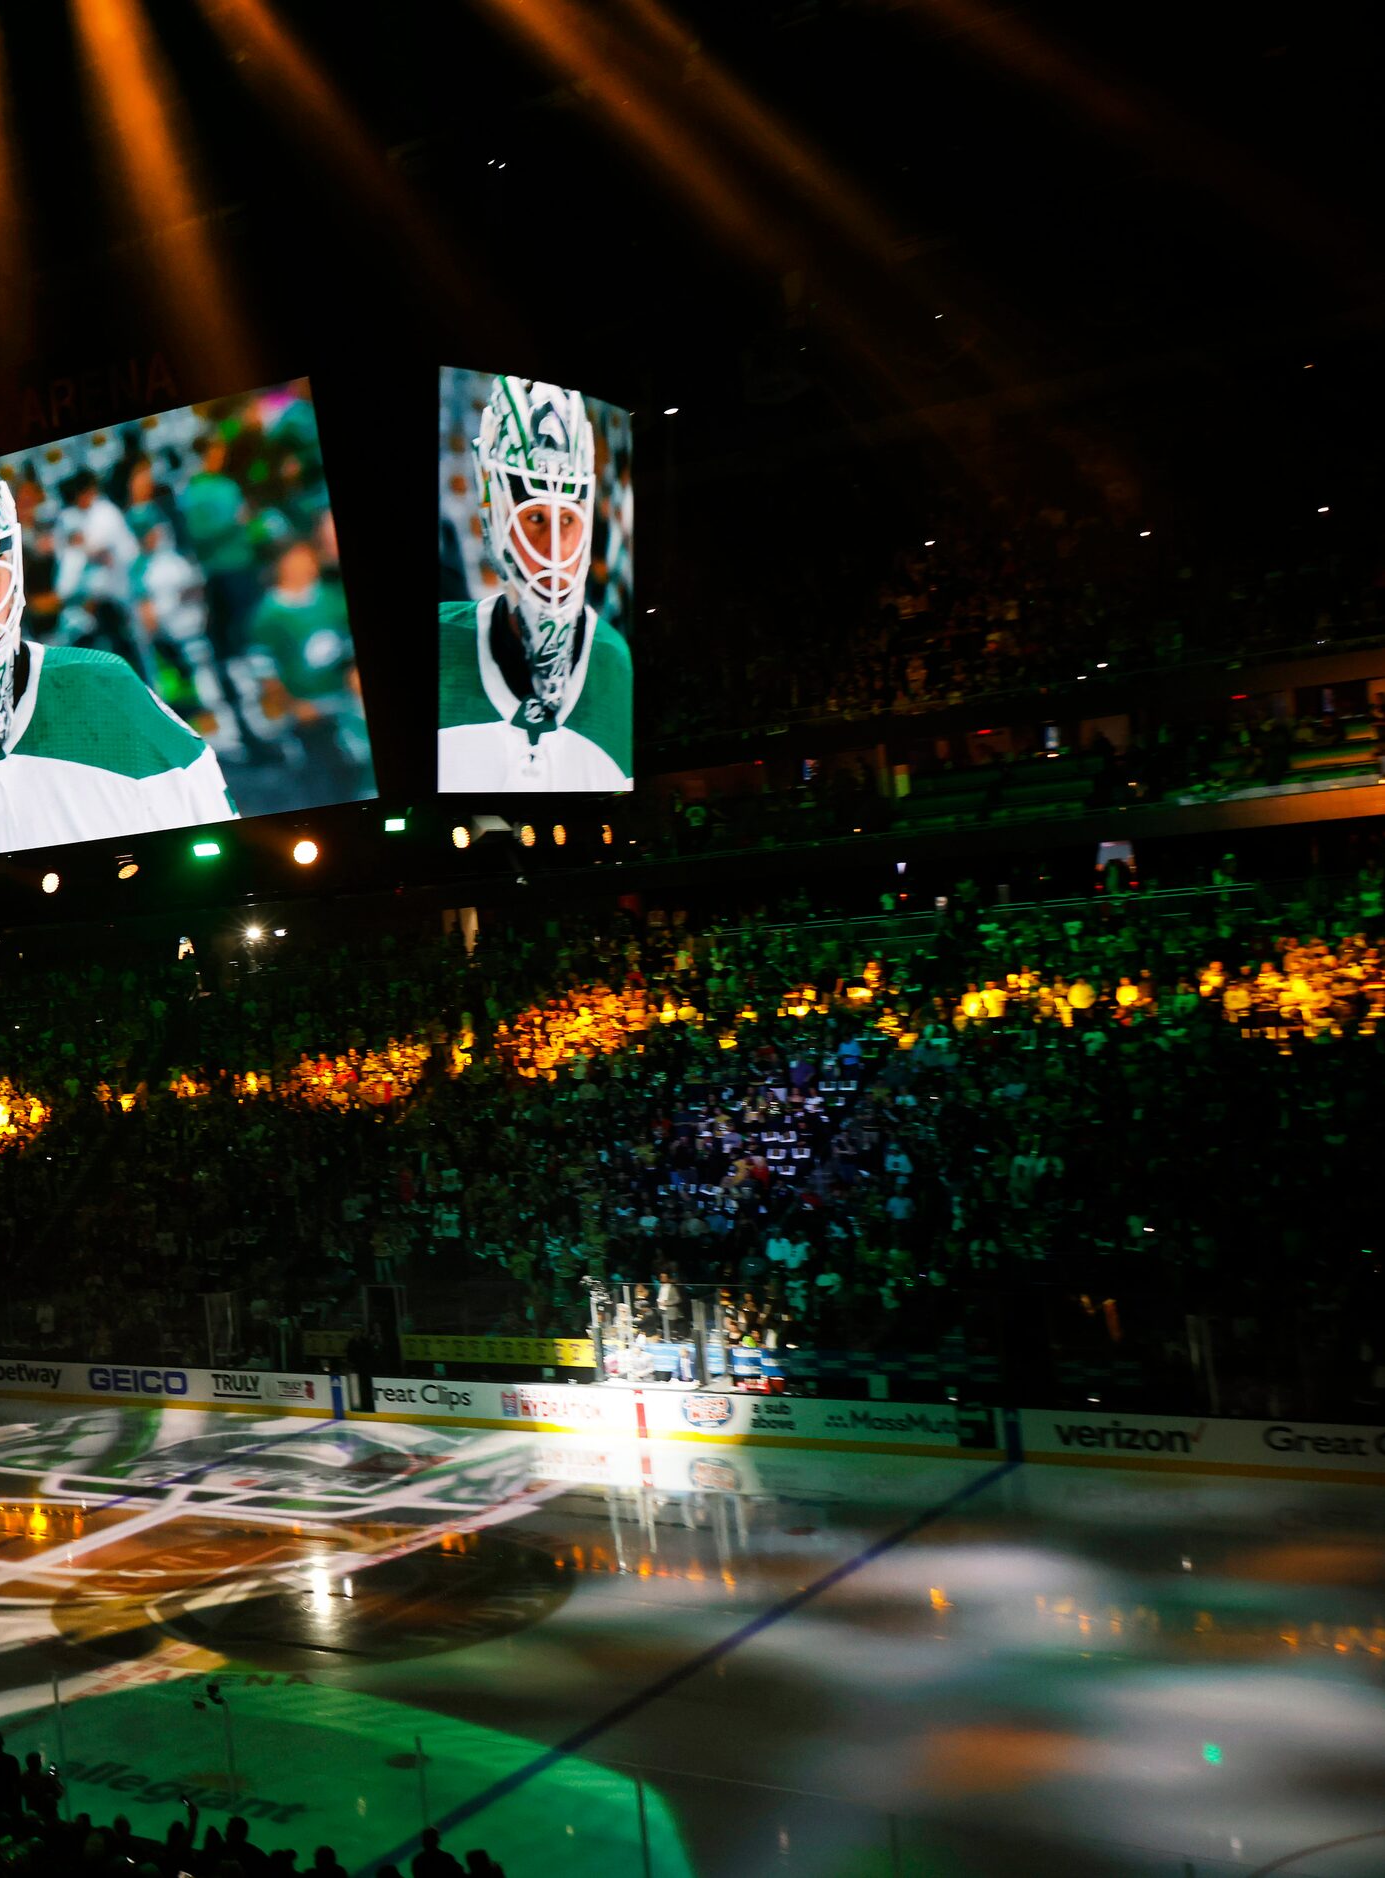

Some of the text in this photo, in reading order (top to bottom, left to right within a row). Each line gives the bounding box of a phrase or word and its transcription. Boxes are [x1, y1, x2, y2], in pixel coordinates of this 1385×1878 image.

[89, 1367, 188, 1395] GEICO
[211, 1374, 259, 1392] TRULY
[374, 1384, 471, 1410] reat Clips
[752, 1401, 792, 1415] a sub
[750, 1416, 796, 1430] above
[1054, 1420, 1191, 1452] verizon
[1263, 1426, 1368, 1456] Great
